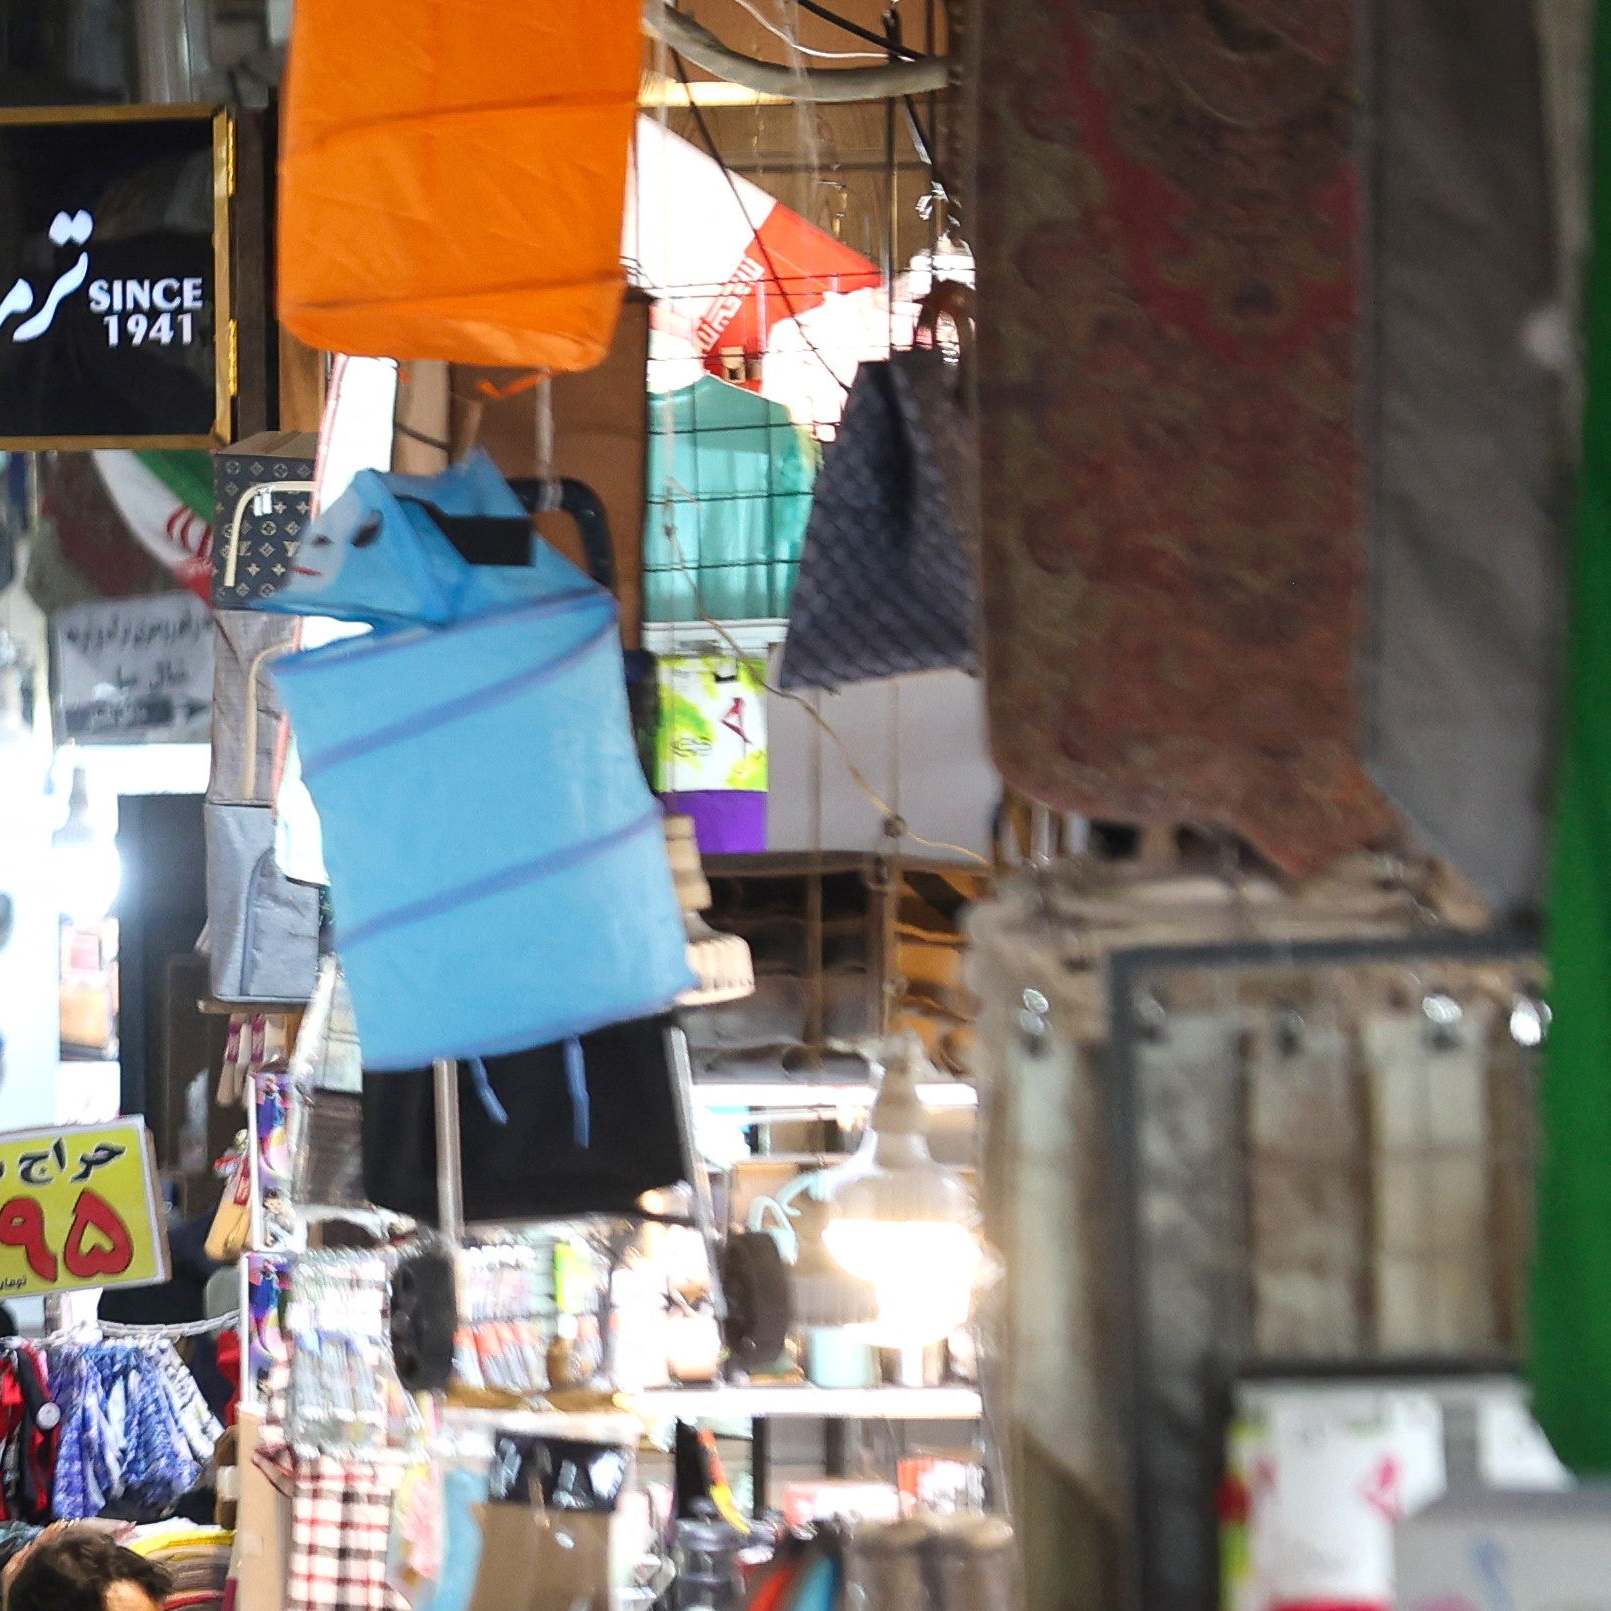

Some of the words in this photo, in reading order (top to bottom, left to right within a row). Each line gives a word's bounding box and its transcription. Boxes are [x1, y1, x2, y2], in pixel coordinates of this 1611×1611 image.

[88, 277, 204, 313] SINCE
[103, 312, 195, 348] 1941
[18, 1137, 127, 1185] حراج
